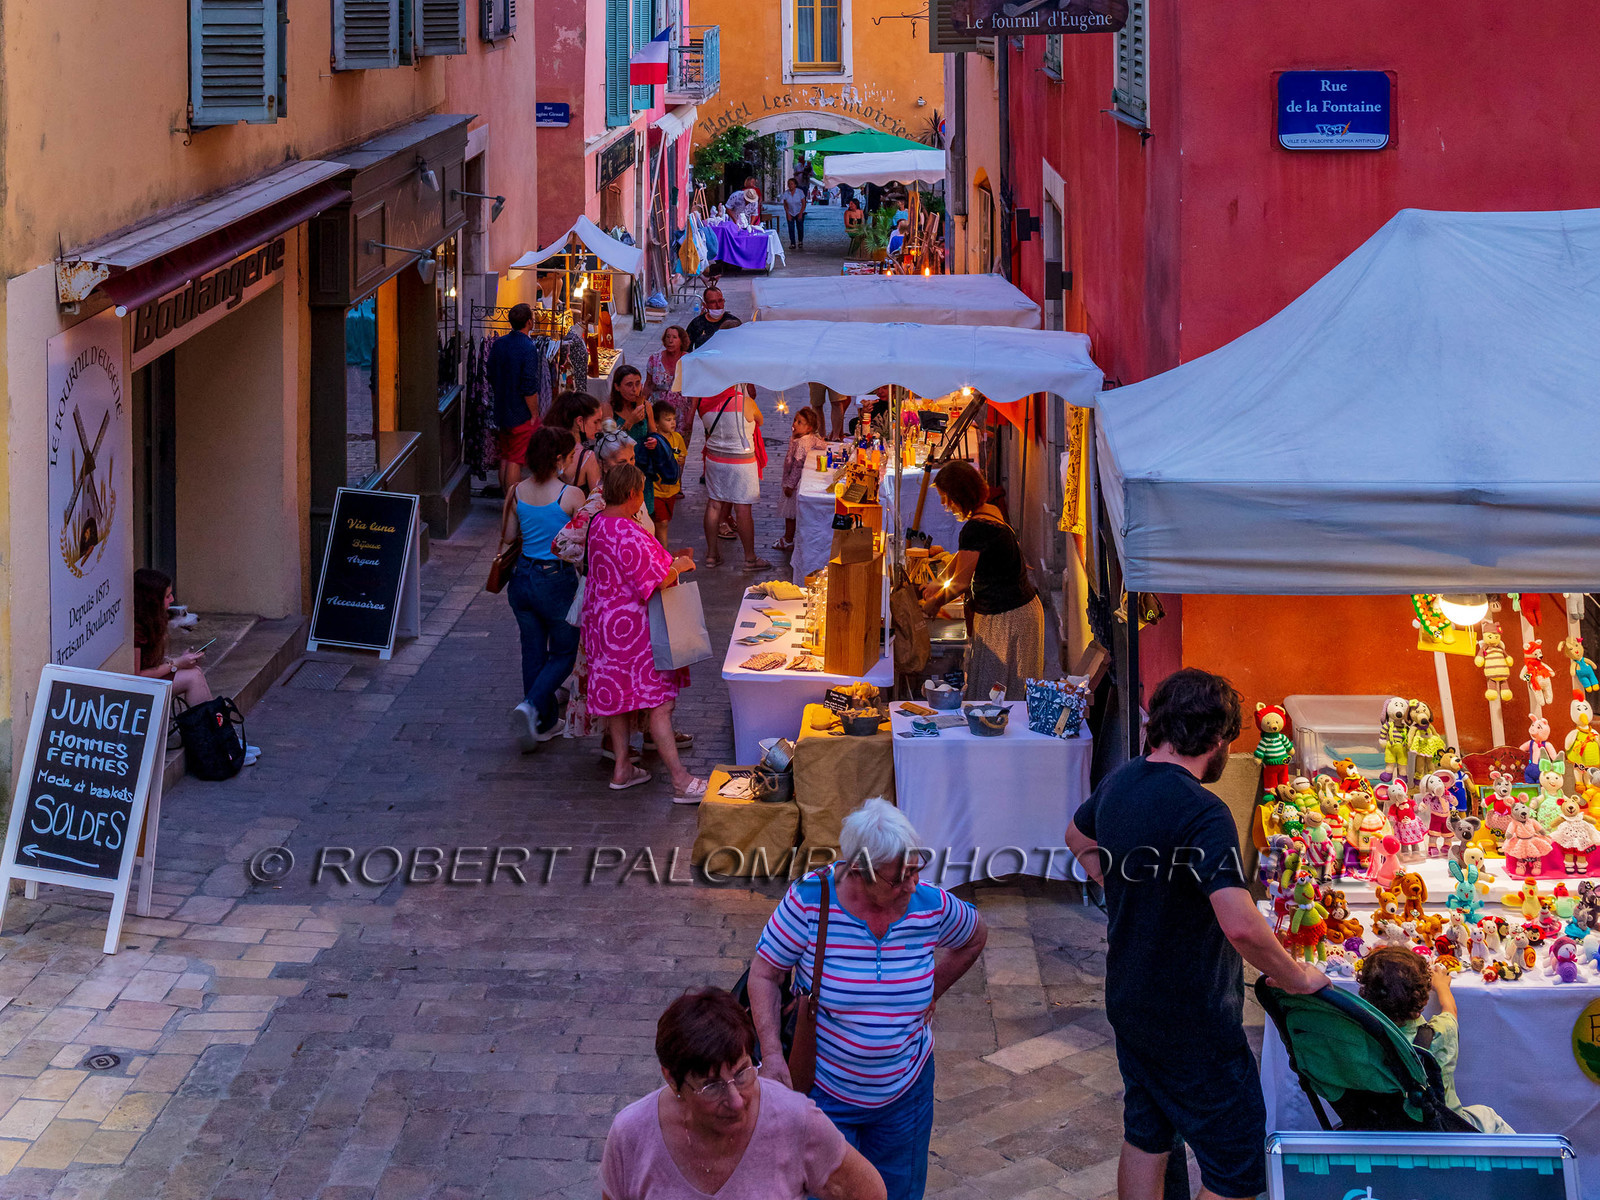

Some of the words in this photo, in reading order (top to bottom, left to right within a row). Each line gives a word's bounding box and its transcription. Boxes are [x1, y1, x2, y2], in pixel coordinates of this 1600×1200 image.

[965, 14, 984, 29] Le
[992, 11, 1040, 29] fournil
[1047, 11, 1113, 32] d'Eugène
[1320, 79, 1348, 92] Rue
[1286, 99, 1303, 113] de
[1306, 99, 1318, 113] la
[1321, 99, 1382, 113] Fontaine
[132, 237, 286, 354] Boulangerie
[347, 518, 368, 530] Via
[346, 554, 380, 567] Argent
[69, 594, 95, 630] Depuis
[95, 578, 110, 605] 1873
[326, 595, 386, 611] Accessoires
[56, 633, 84, 666] Artisan
[85, 597, 122, 643] Boulanger
[51, 689, 147, 736] JUNGLE
[49, 730, 129, 760] HOMMES
[46, 747, 129, 777] FEMMES
[37, 769, 72, 788] Mode
[89, 781, 134, 803] baskets
[31, 793, 126, 851] SOLDES
